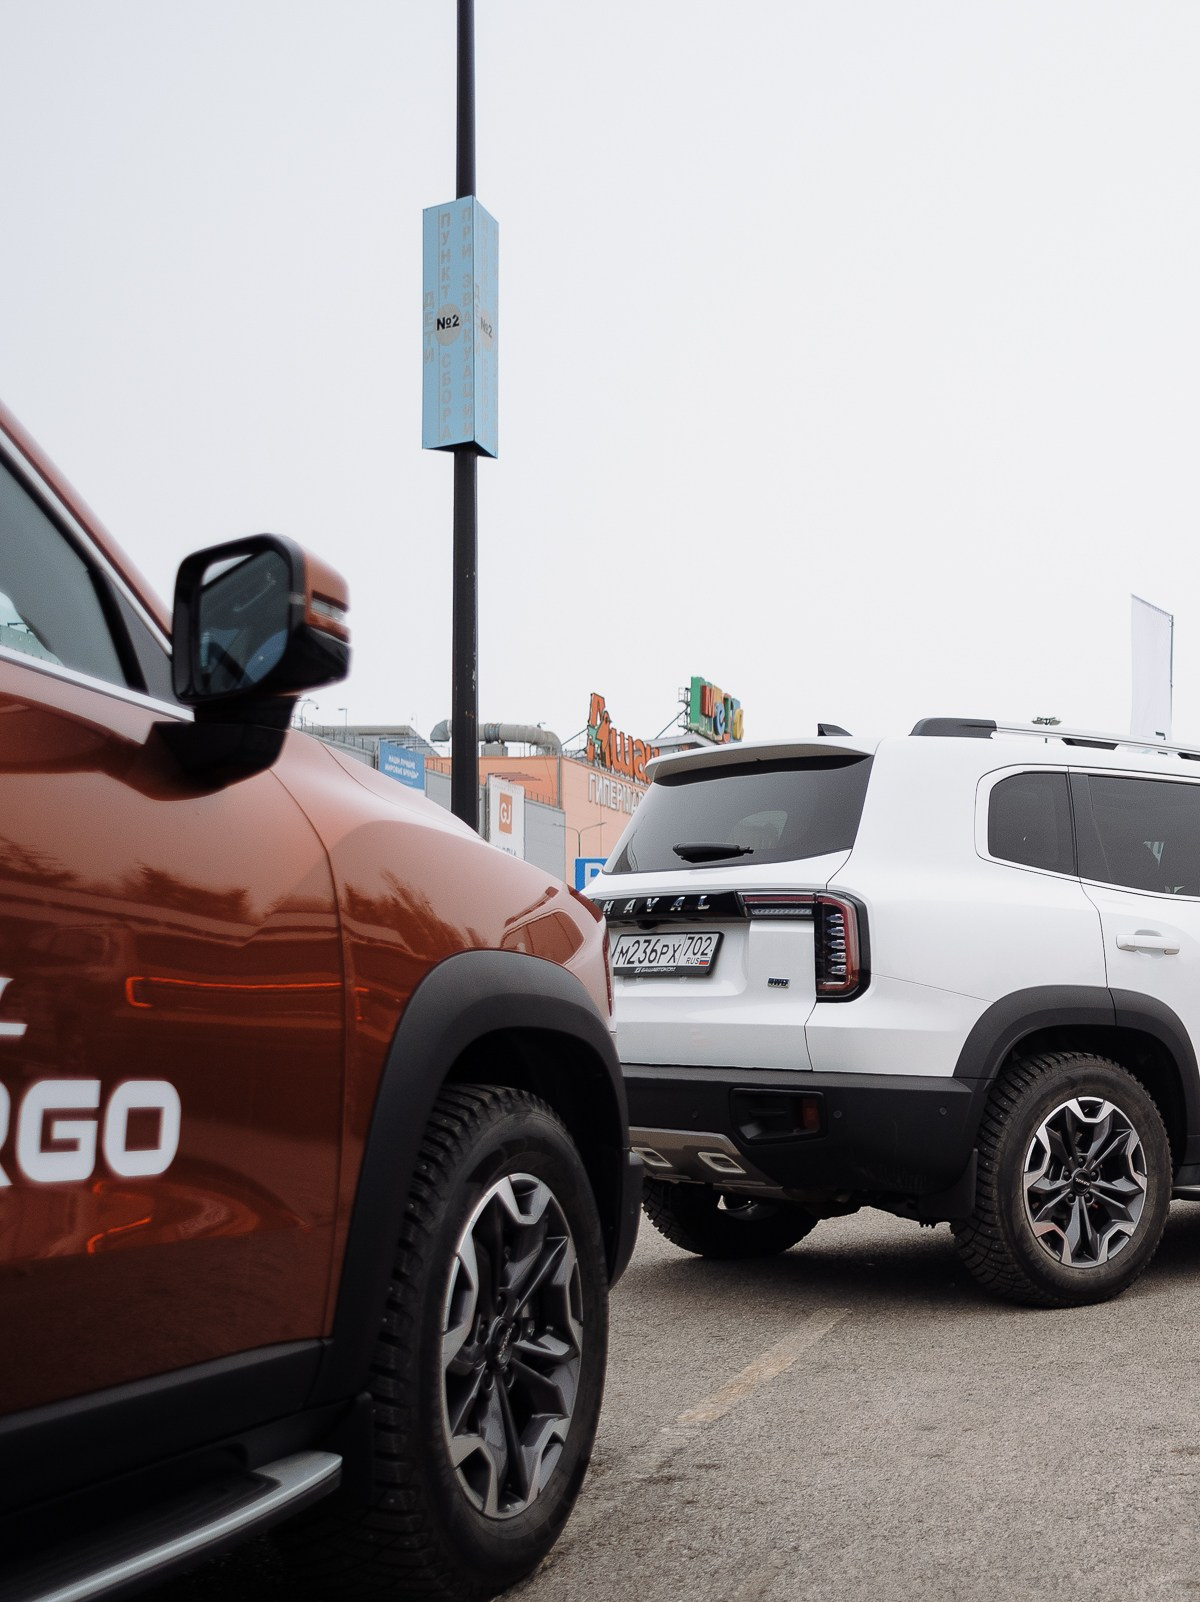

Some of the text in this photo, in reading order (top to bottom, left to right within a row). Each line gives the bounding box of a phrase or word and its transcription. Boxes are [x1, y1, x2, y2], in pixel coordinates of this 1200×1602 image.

[436, 314, 460, 331] №2
[501, 802, 512, 825] GJ
[602, 895, 710, 915] HAVAL
[683, 936, 713, 957] 702
[686, 956, 699, 965] RUS
[0, 1078, 182, 1186] GO
